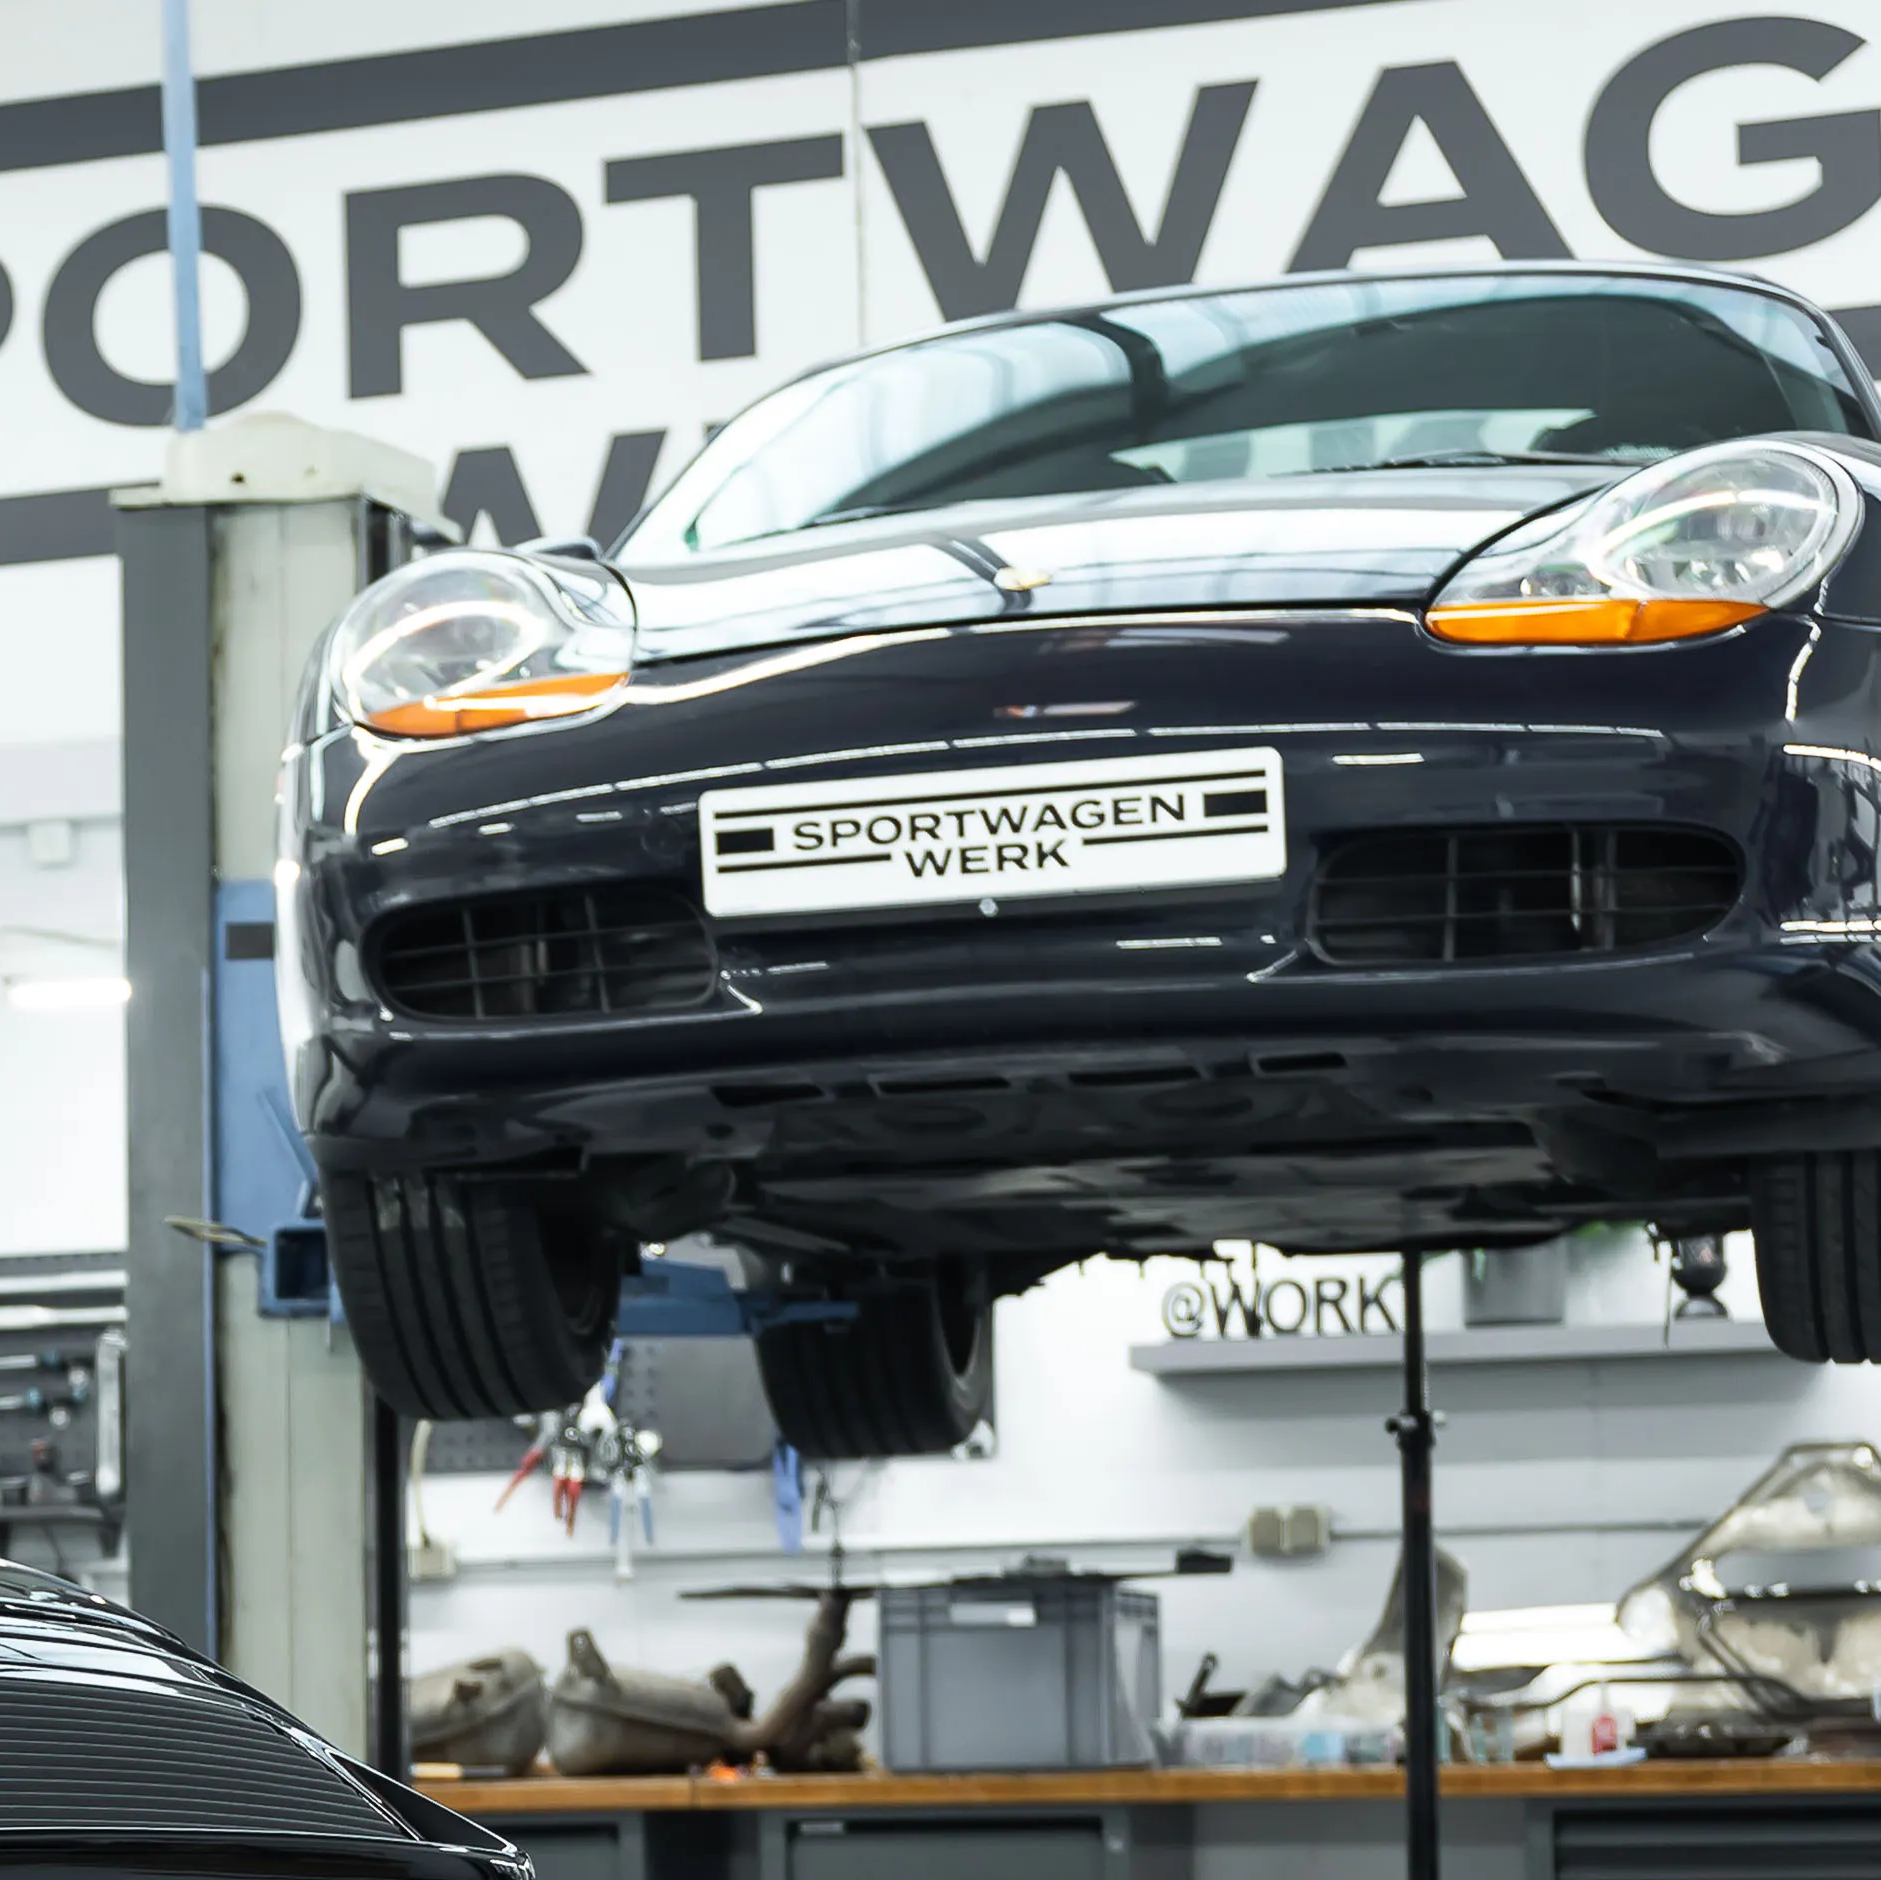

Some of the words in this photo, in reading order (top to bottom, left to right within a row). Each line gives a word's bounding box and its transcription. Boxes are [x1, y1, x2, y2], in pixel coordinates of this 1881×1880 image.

[792, 794, 1186, 851] SPORTWAGEN
[904, 840, 1070, 879] WERK
[1162, 1275, 1400, 1338] @WORK
